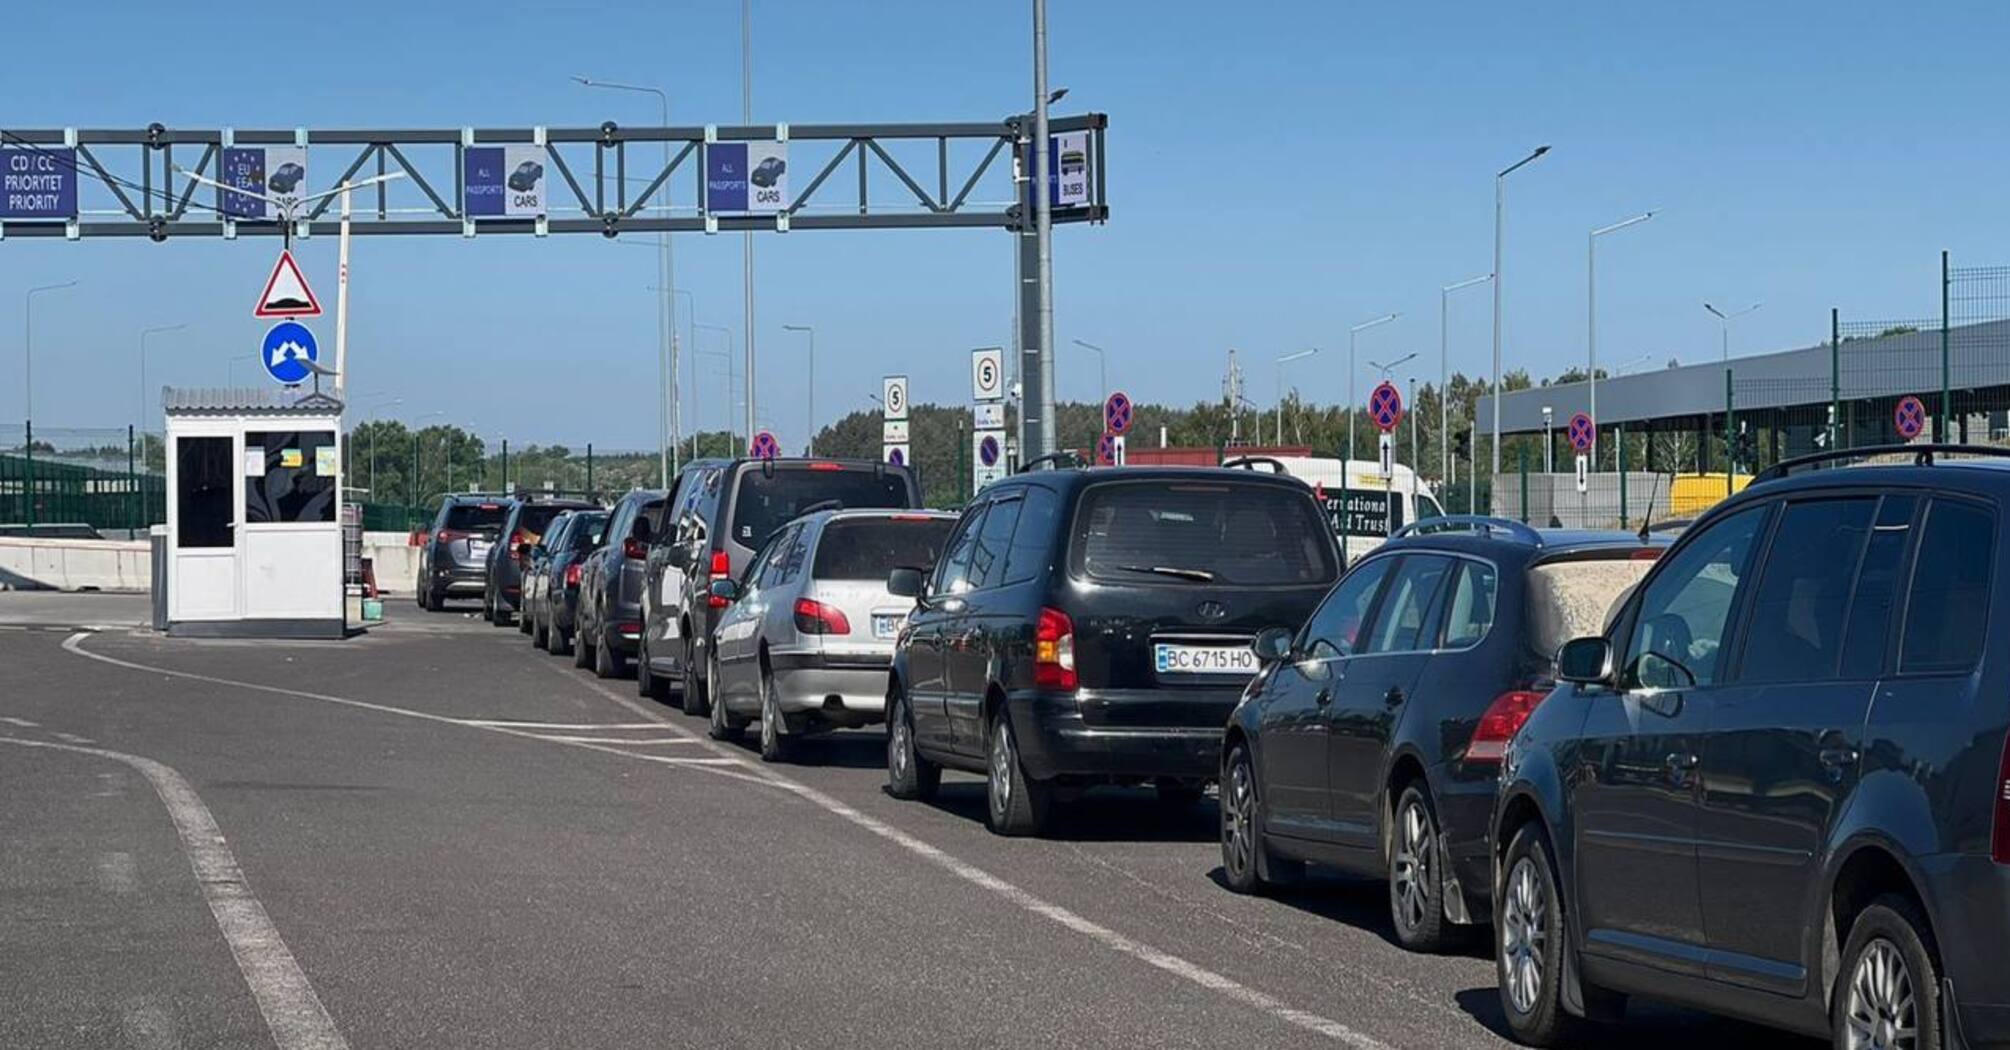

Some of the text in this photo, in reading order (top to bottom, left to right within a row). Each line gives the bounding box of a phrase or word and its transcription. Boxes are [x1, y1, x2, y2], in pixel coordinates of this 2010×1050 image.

[11, 155, 28, 171] CD
[37, 155, 55, 171] CC
[237, 163, 251, 176] EU
[5, 174, 63, 191] PRIORYTET
[1063, 183, 1083, 196] BUSES
[9, 194, 59, 211] PRIORITY
[514, 195, 538, 207] CARS
[757, 190, 780, 203] CARS
[983, 366, 991, 382] 5
[892, 391, 899, 405] 5
[1168, 650, 1253, 668] BC 6715 HO
